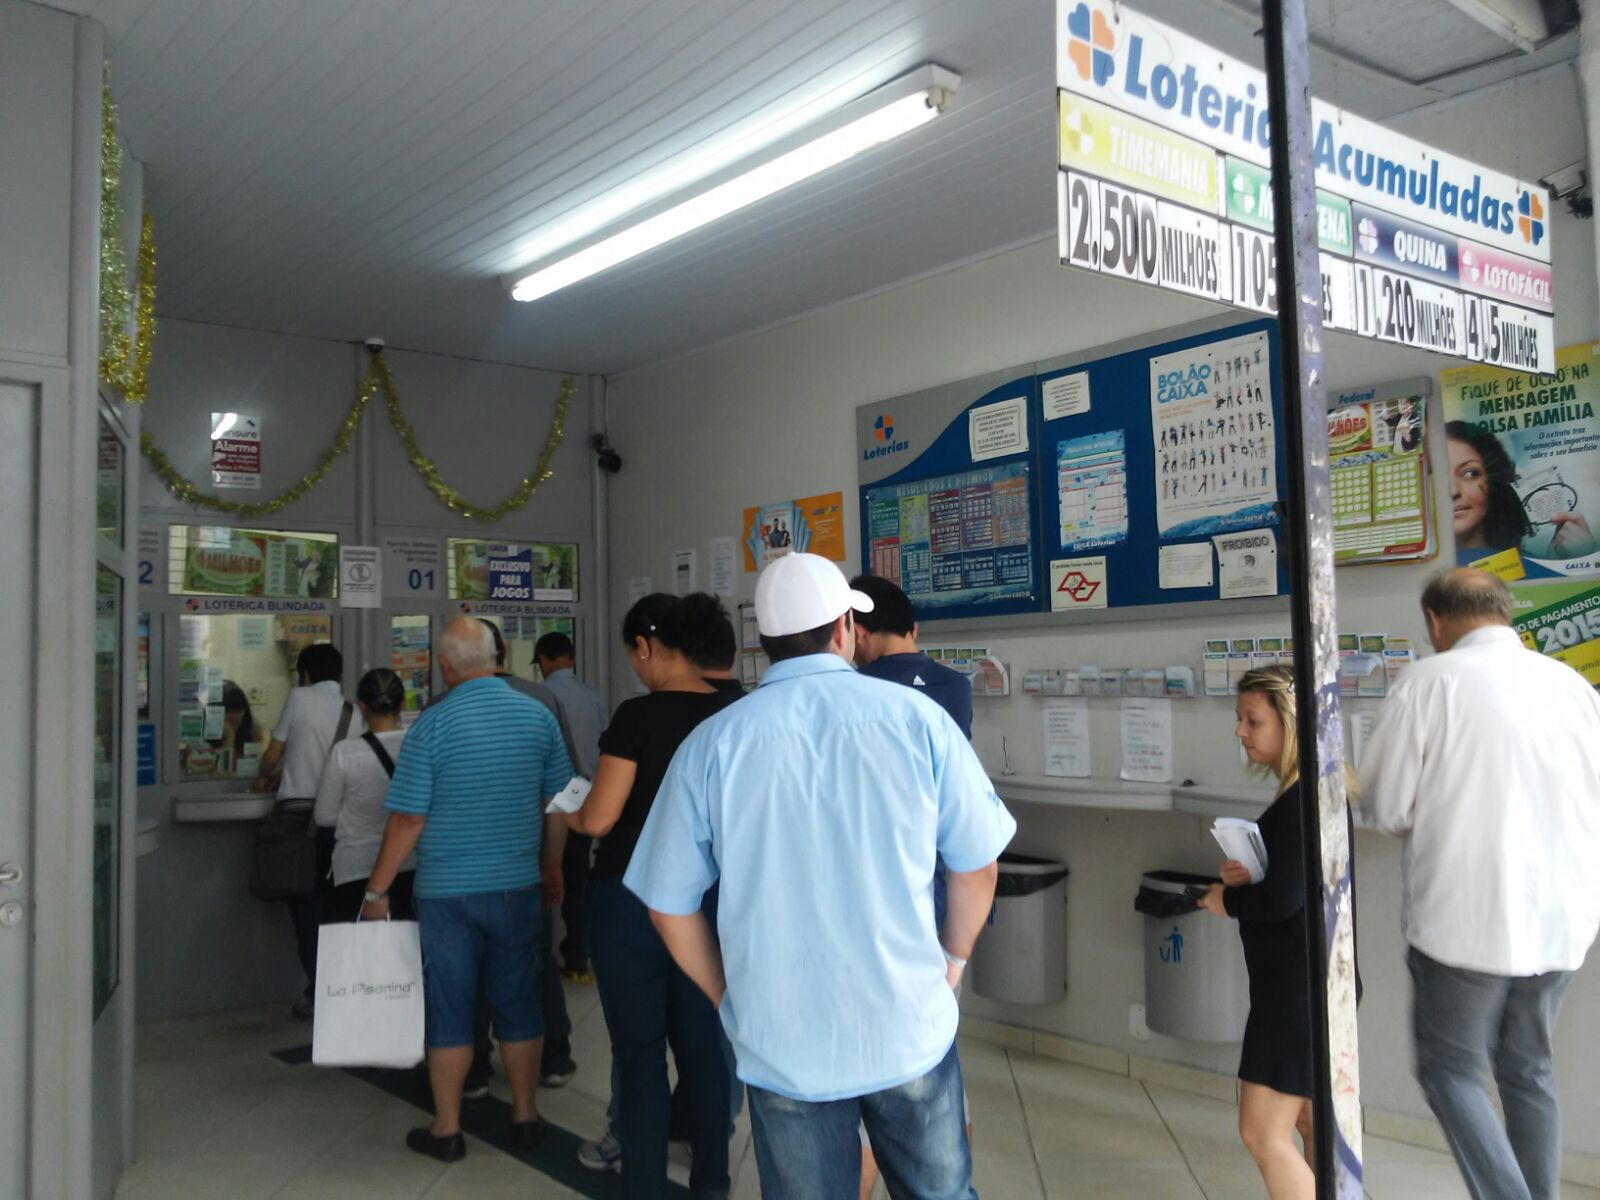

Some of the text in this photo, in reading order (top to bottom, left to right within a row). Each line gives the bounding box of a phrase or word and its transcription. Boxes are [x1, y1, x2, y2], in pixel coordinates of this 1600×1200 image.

[1109, 124, 1209, 198] TIMEMANIA
[1313, 119, 1514, 235] Acumuladas
[1317, 203, 1348, 245] ENA
[1161, 220, 1218, 294] MILHÕES
[1393, 229, 1447, 272] QUINA
[1483, 262, 1551, 303] LOTOFÁCIL
[1416, 293, 1456, 352] MILHÕES
[1502, 315, 1539, 369] MILHÕES
[1158, 363, 1212, 389] BOLÃO
[1506, 376, 1524, 392] DE
[1572, 363, 1589, 381] NA
[1157, 380, 1208, 404] CAIXA
[1338, 389, 1376, 405] Federal
[1479, 384, 1577, 416] MENSAGEM
[1523, 402, 1594, 429] FAMÍLIA
[215, 440, 257, 453] Alarme
[864, 440, 909, 461] Loterias
[1222, 536, 1269, 551] PROIBIDO
[490, 560, 531, 573] EXCLUSIVO
[1565, 562, 1590, 570] CAIXA
[408, 568, 435, 591] 01
[499, 574, 522, 586] PARA
[268, 601, 326, 611] BLINDADA
[491, 587, 531, 599] JOGOS
[524, 605, 570, 614] BLINDADA
[1528, 595, 1600, 630] DE PAGAMENTO
[1536, 607, 1600, 655] 2015
